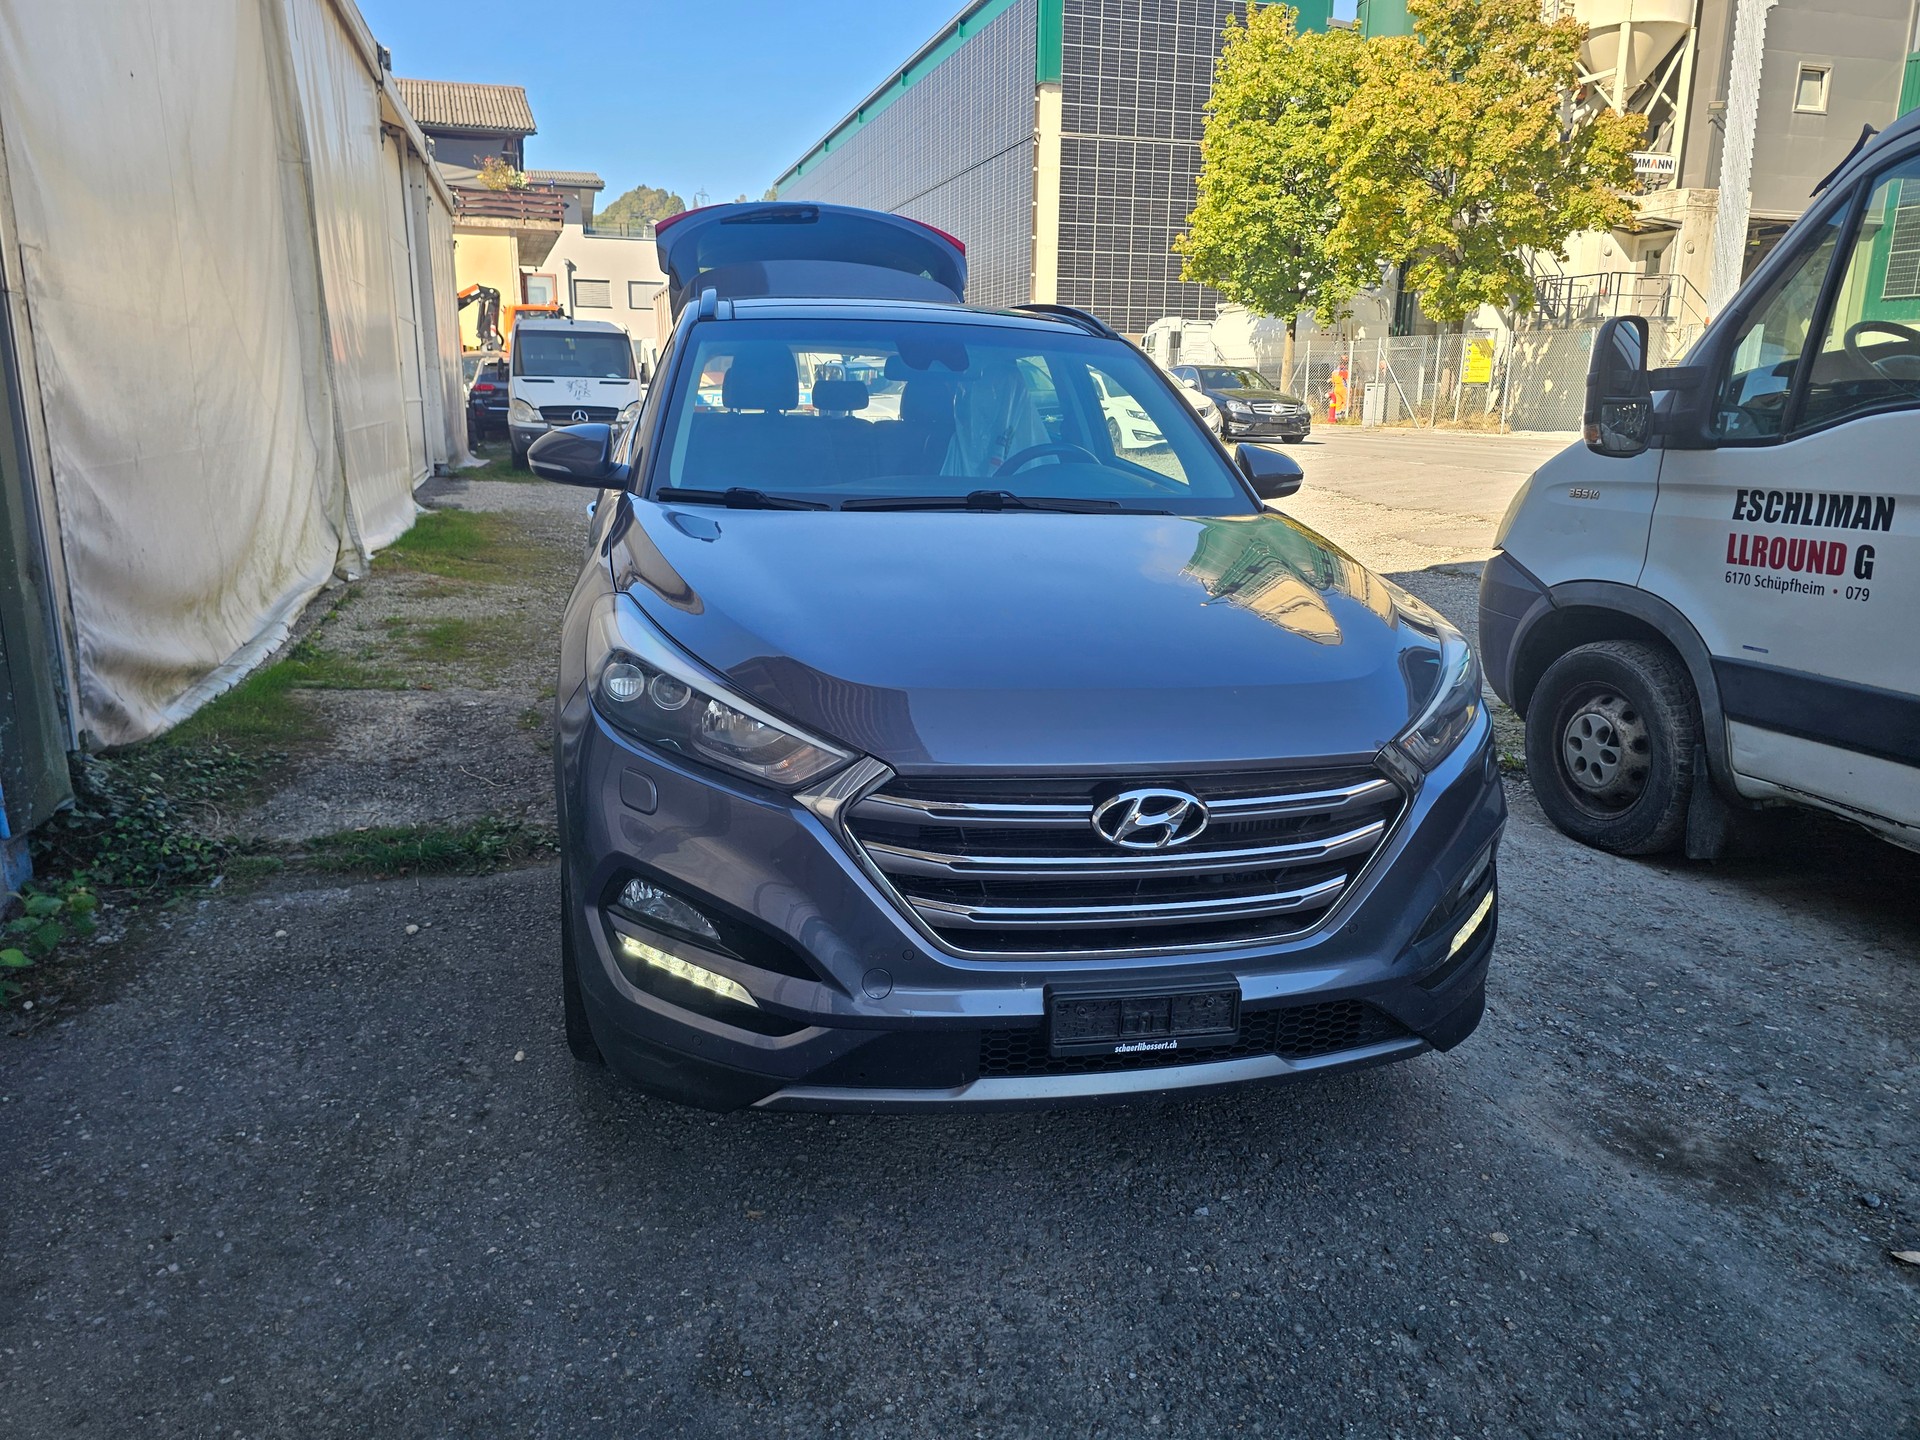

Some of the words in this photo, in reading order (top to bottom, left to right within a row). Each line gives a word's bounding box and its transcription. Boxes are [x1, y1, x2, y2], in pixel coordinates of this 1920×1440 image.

[1636, 158, 1673, 170] MMANN
[1732, 489, 1896, 532] ESCHLIMAN
[1726, 533, 1848, 576] LLROUND
[1853, 544, 1876, 580] G
[1725, 571, 1751, 586] 6170
[1754, 575, 1825, 596] Schüpfheim
[1845, 586, 1870, 602] 079
[1114, 1040, 1178, 1053] schaerlibossert.ch
